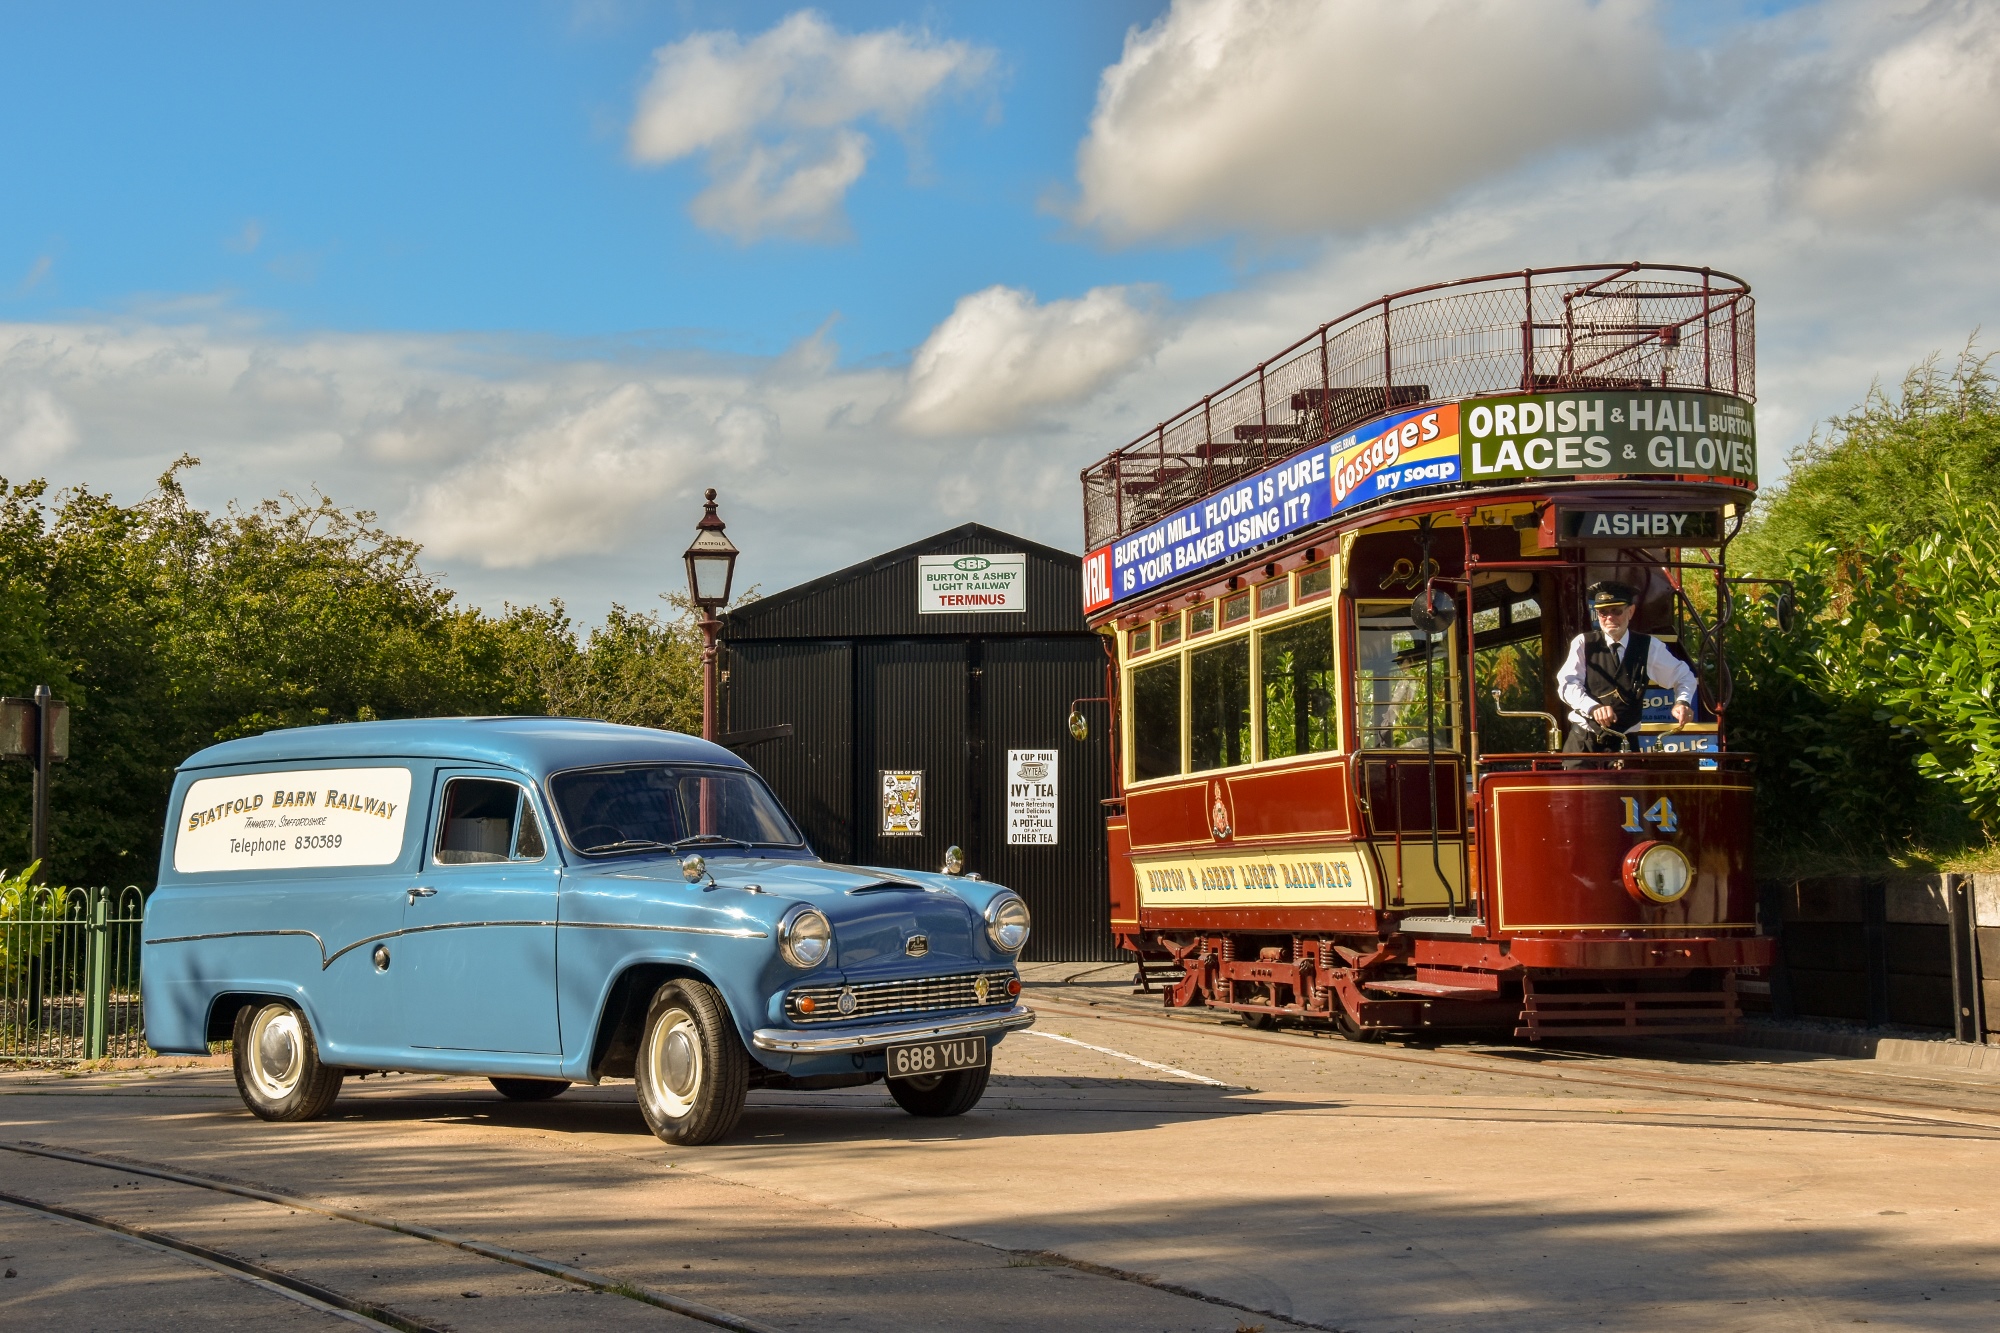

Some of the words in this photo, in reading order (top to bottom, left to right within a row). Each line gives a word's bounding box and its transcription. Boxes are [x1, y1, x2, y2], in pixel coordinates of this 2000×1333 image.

[1468, 400, 1604, 438] ORDISH
[1610, 408, 1624, 422] &
[1629, 400, 1706, 432] HALL
[1723, 405, 1744, 416] LIMITED
[1709, 414, 1752, 438] BURTON
[1334, 413, 1439, 502] Gossages
[1472, 436, 1611, 474] LACES
[1622, 444, 1637, 460] &
[1648, 436, 1753, 475] GLOVES
[1404, 462, 1455, 482] soap
[1115, 528, 1164, 568] BURTON
[1168, 513, 1200, 544] MILL
[1206, 487, 1252, 529] FLOUR
[1258, 478, 1274, 506] IS
[1278, 453, 1325, 494] PURE
[1592, 514, 1687, 534] ASHBY
[1123, 569, 1135, 591] IS
[1138, 555, 1172, 585] YOUR
[1176, 530, 1224, 570] BAKER
[1228, 510, 1280, 548] USING
[1284, 492, 1310, 526] IT?
[958, 560, 986, 569] SBR
[926, 573, 968, 581] BURTON
[984, 572, 1017, 580] ASHBY
[966, 582, 1010, 590] RAILWAY
[939, 594, 1006, 606] TERMINUS
[1012, 784, 1030, 797] IVY
[1034, 784, 1054, 797] TEA
[188, 794, 263, 831] STATFOLD
[272, 790, 316, 808] BARN
[325, 790, 397, 820] RAILWAY
[279, 815, 327, 827] STAFFORDSHIRE
[1620, 796, 1678, 832] 14
[1012, 819, 1017, 827] A
[1020, 819, 1053, 827] POT-FULL
[230, 837, 286, 856] Telephone
[295, 834, 342, 849] 830389
[1012, 834, 1036, 842] OTHER
[1039, 834, 1053, 842] TEA
[1147, 868, 1186, 892] BURTON
[1188, 867, 1198, 890] &
[1201, 865, 1238, 890] ASHBY
[1239, 864, 1278, 889] LIGHT
[1280, 861, 1352, 889] RAILWAYS
[897, 1046, 935, 1072] 688
[940, 1041, 977, 1066] YUJ
